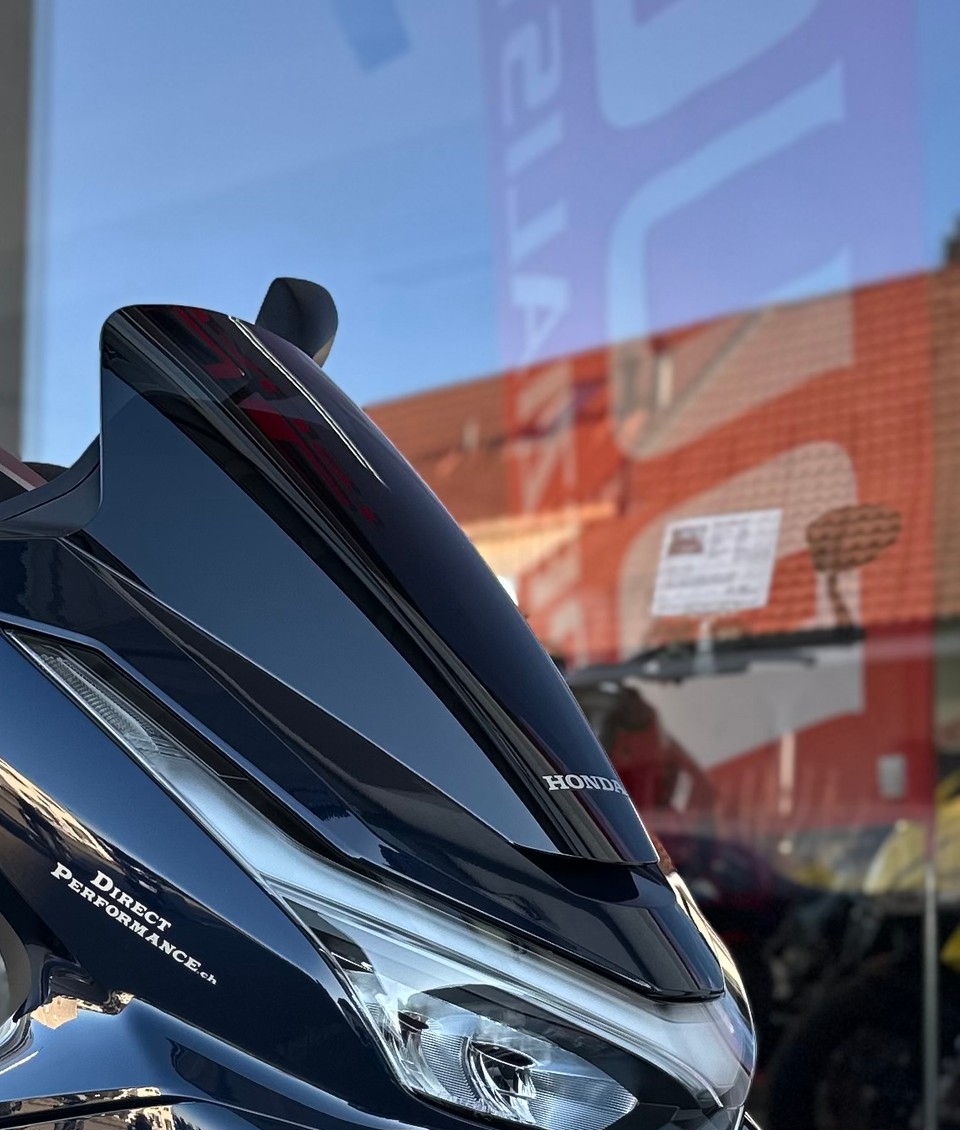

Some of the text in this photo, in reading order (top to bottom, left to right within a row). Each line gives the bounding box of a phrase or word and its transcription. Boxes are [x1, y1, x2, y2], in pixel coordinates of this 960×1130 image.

[542, 774, 628, 797] HONDA
[50, 861, 218, 986] PERFORMANCE.ch
[90, 870, 172, 932] DIRECT
